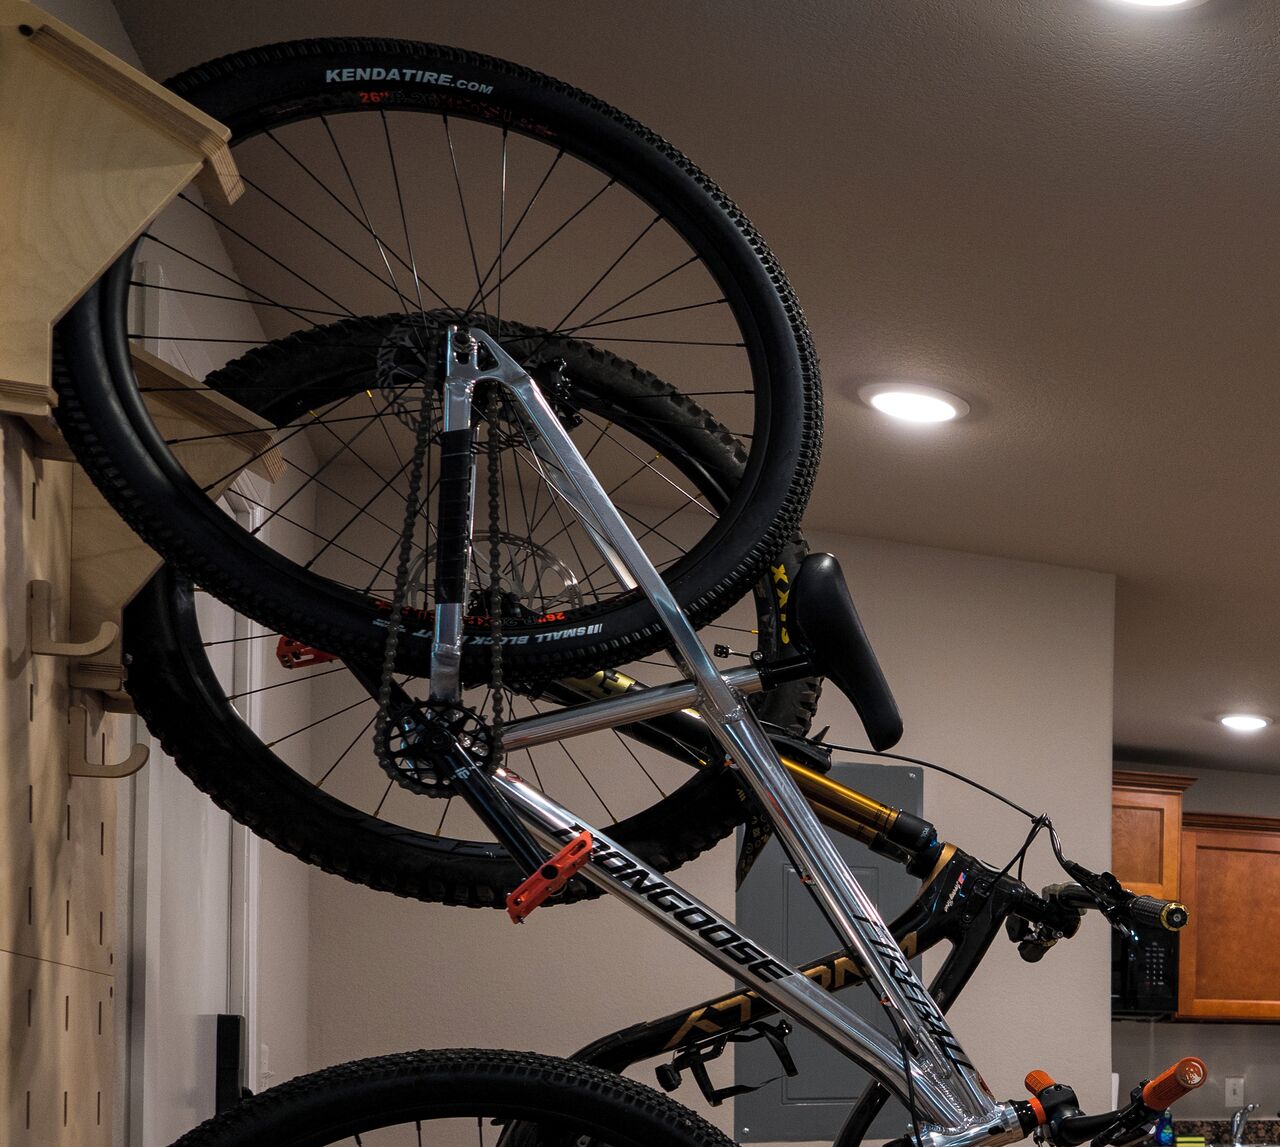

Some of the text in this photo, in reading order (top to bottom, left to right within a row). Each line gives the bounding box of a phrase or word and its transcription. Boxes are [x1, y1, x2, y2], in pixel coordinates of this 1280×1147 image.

[323, 66, 496, 96] KENDATIRE.COM
[535, 624, 589, 645] SMALL
[550, 822, 796, 984] MONGOOSE
[852, 913, 978, 1077] FIREBALL
